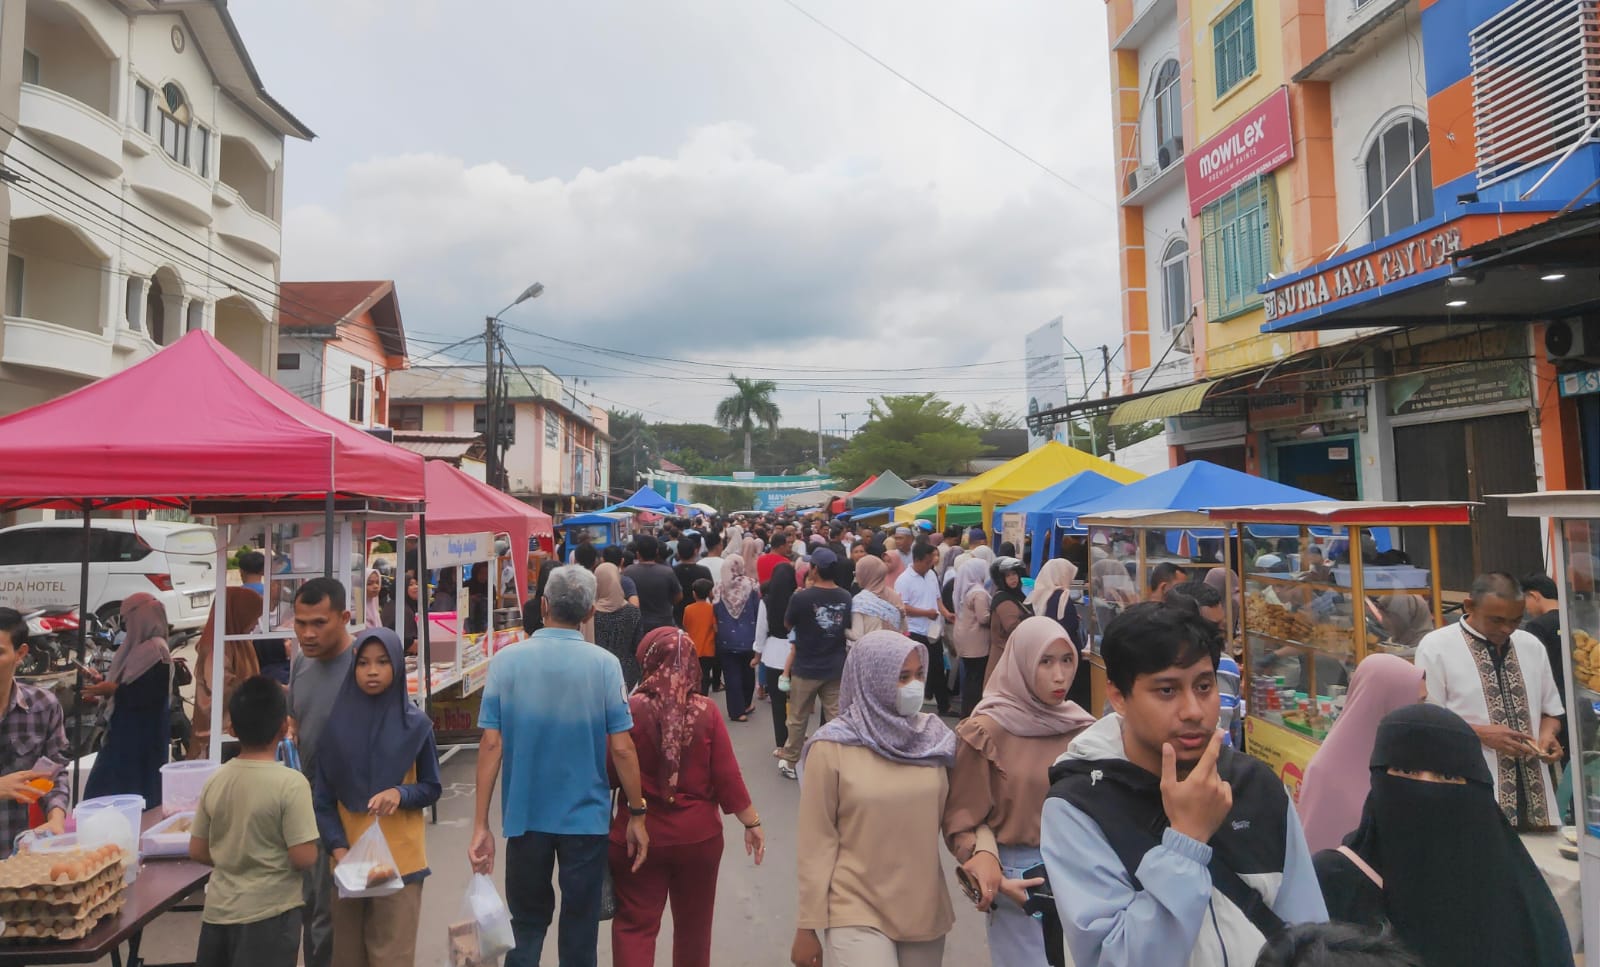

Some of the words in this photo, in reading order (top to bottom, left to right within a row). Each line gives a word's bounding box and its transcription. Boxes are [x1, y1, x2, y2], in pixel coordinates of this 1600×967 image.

[1208, 162, 1234, 182] PREMIUM
[1236, 148, 1257, 166] PAINTS
[1277, 274, 1331, 315] SUTRA
[1334, 258, 1378, 297] JAYA
[1379, 227, 1462, 283] TAYLOR
[27, 581, 66, 592] HOTEL
